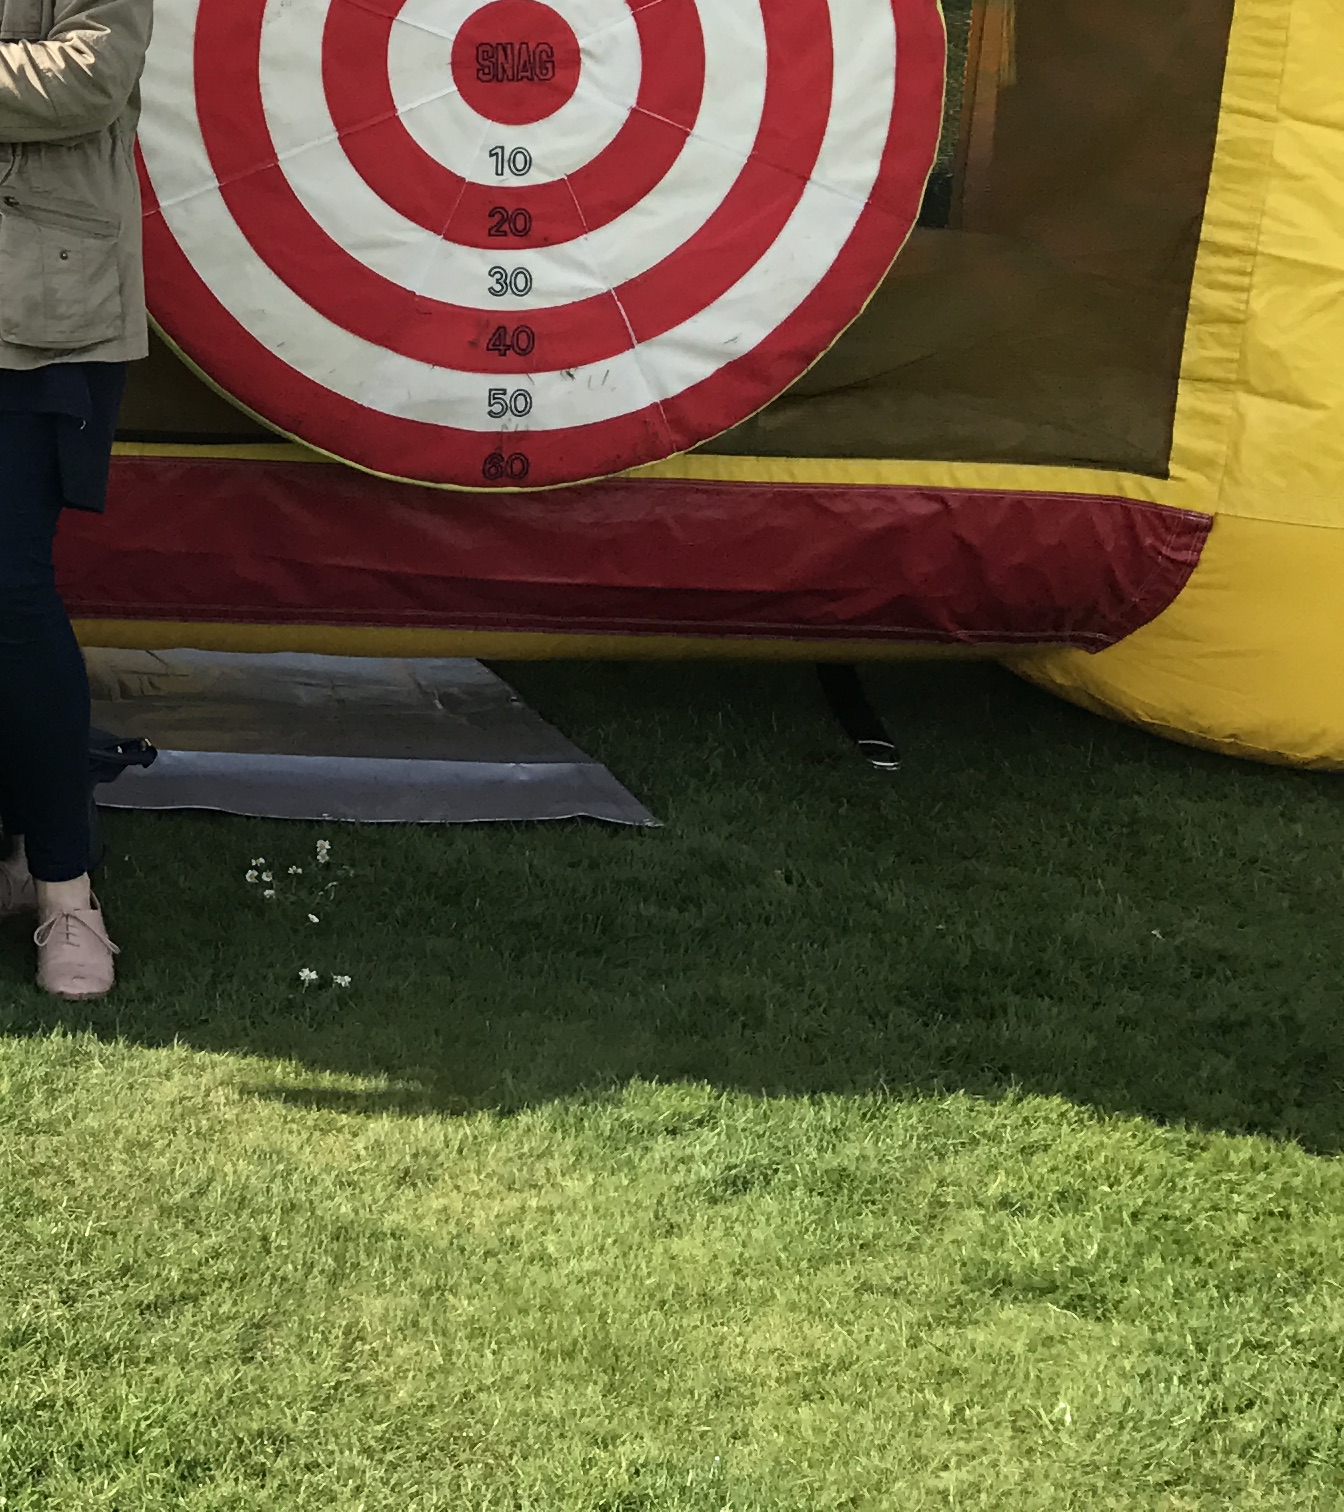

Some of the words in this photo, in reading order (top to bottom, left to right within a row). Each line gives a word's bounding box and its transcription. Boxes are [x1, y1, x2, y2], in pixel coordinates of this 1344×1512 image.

[476, 41, 555, 83] SNAG
[488, 145, 533, 177] 10
[488, 206, 533, 237] 20
[487, 265, 533, 298] 30
[486, 325, 535, 357] 40
[487, 388, 533, 419] 50
[482, 452, 530, 481] 60
